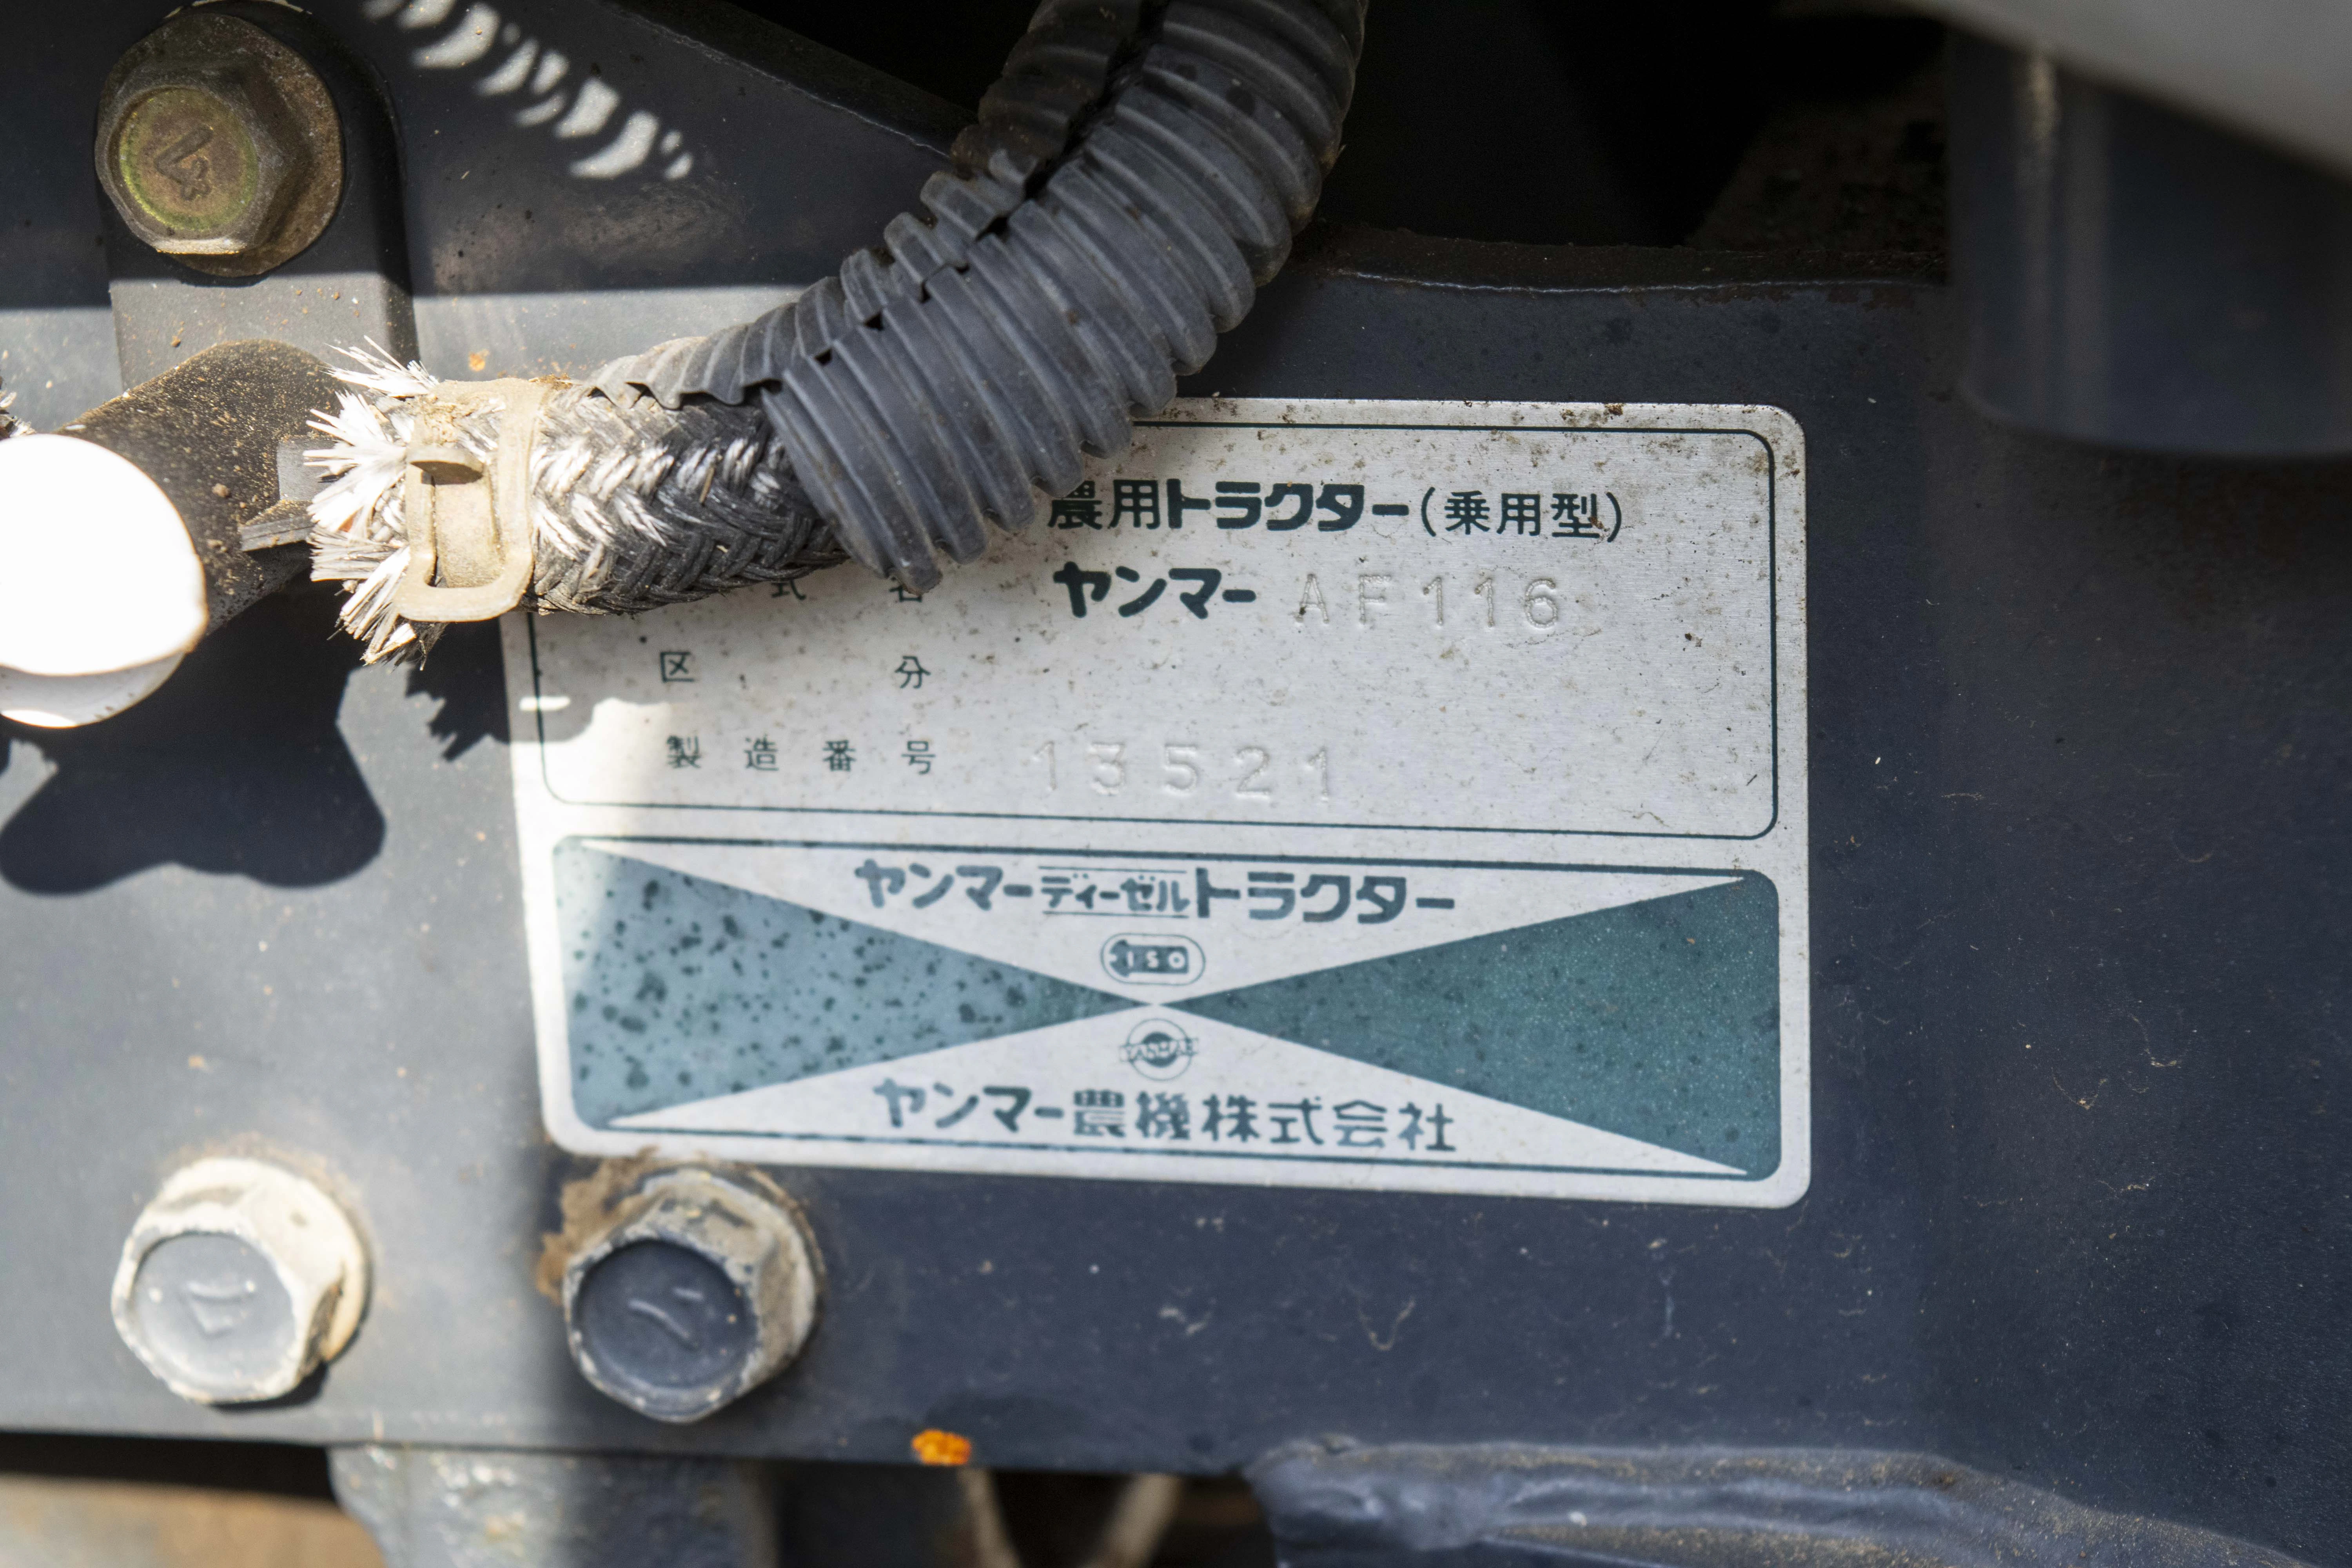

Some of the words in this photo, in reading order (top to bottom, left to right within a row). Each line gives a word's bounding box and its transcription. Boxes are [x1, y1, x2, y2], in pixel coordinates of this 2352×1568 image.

[1053, 561, 1257, 619] ヤンマー
[1295, 572, 1560, 629] AF116
[666, 734, 937, 775] 製造番号
[1032, 739, 1330, 803] 13521
[1126, 949, 1187, 971] ISO
[873, 1077, 1457, 1152] ヤンマー農機株式会社
